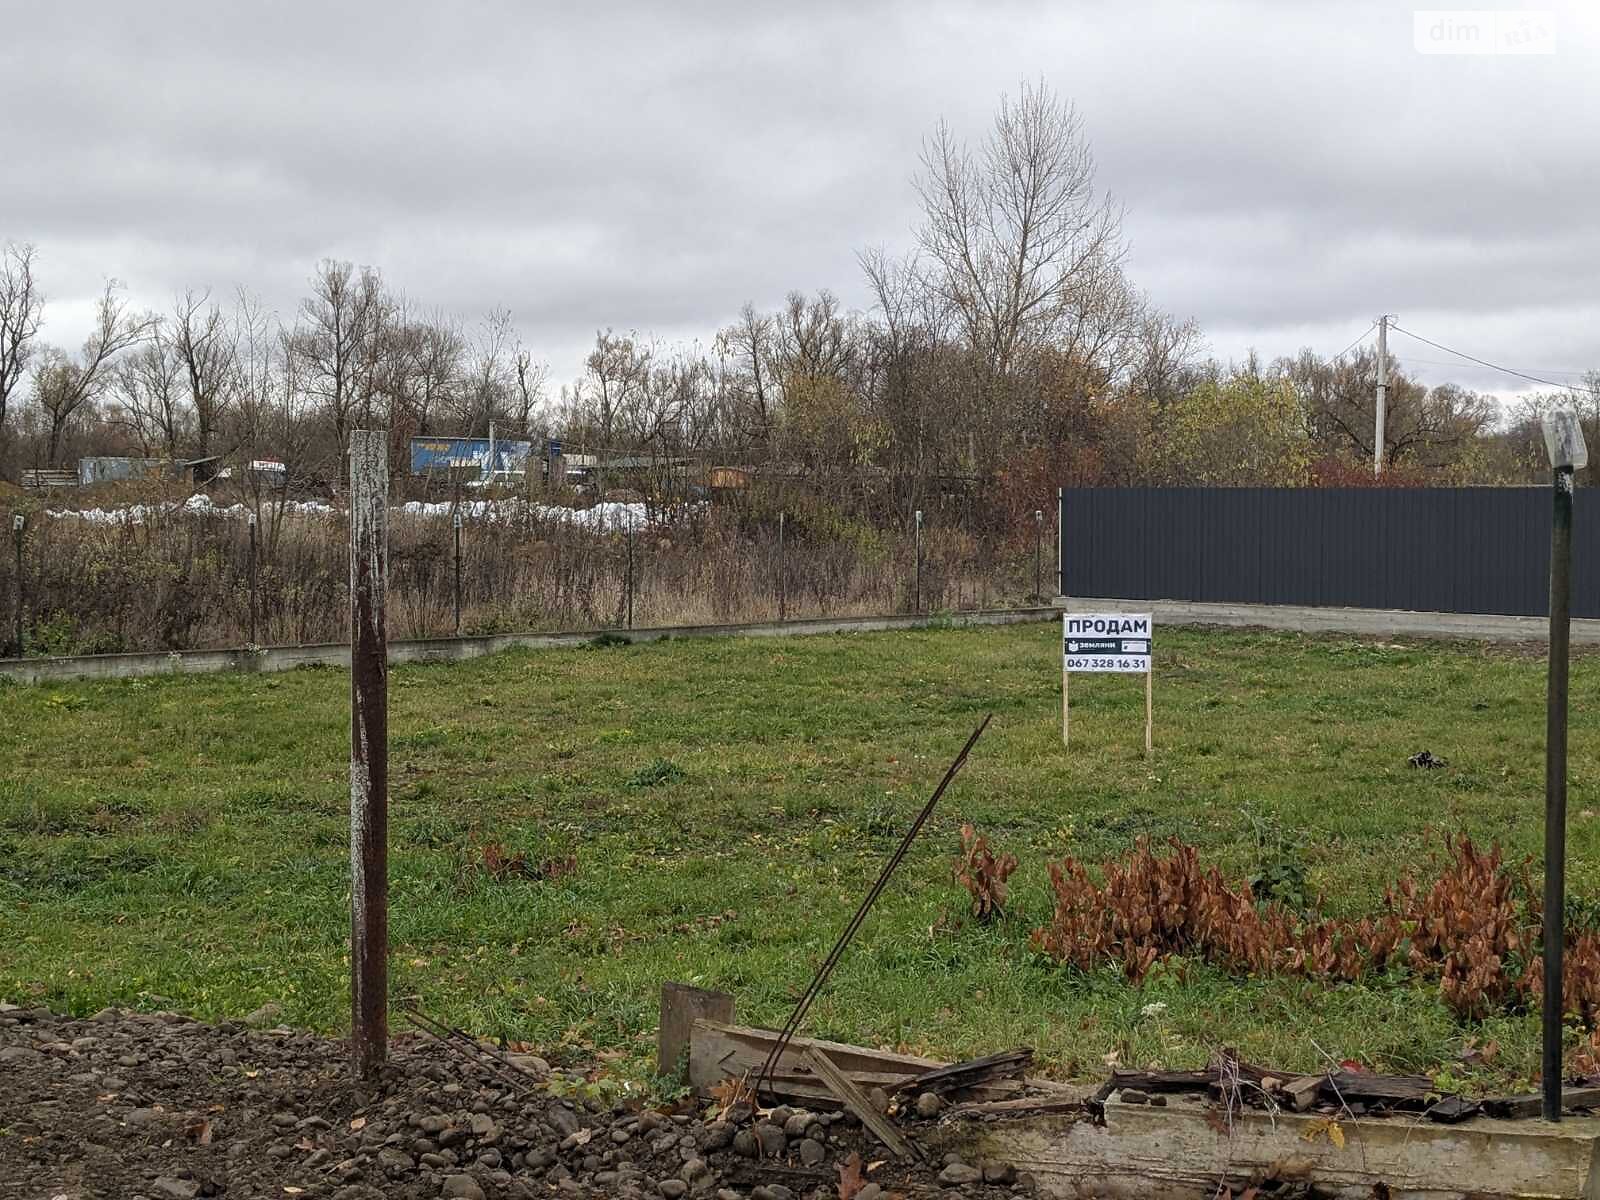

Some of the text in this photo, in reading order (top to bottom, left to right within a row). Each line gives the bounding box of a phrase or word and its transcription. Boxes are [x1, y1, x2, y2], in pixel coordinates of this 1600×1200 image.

[1068, 619, 1147, 635] ПРОДАМ
[1067, 659, 1146, 668] 067 328 16 31
